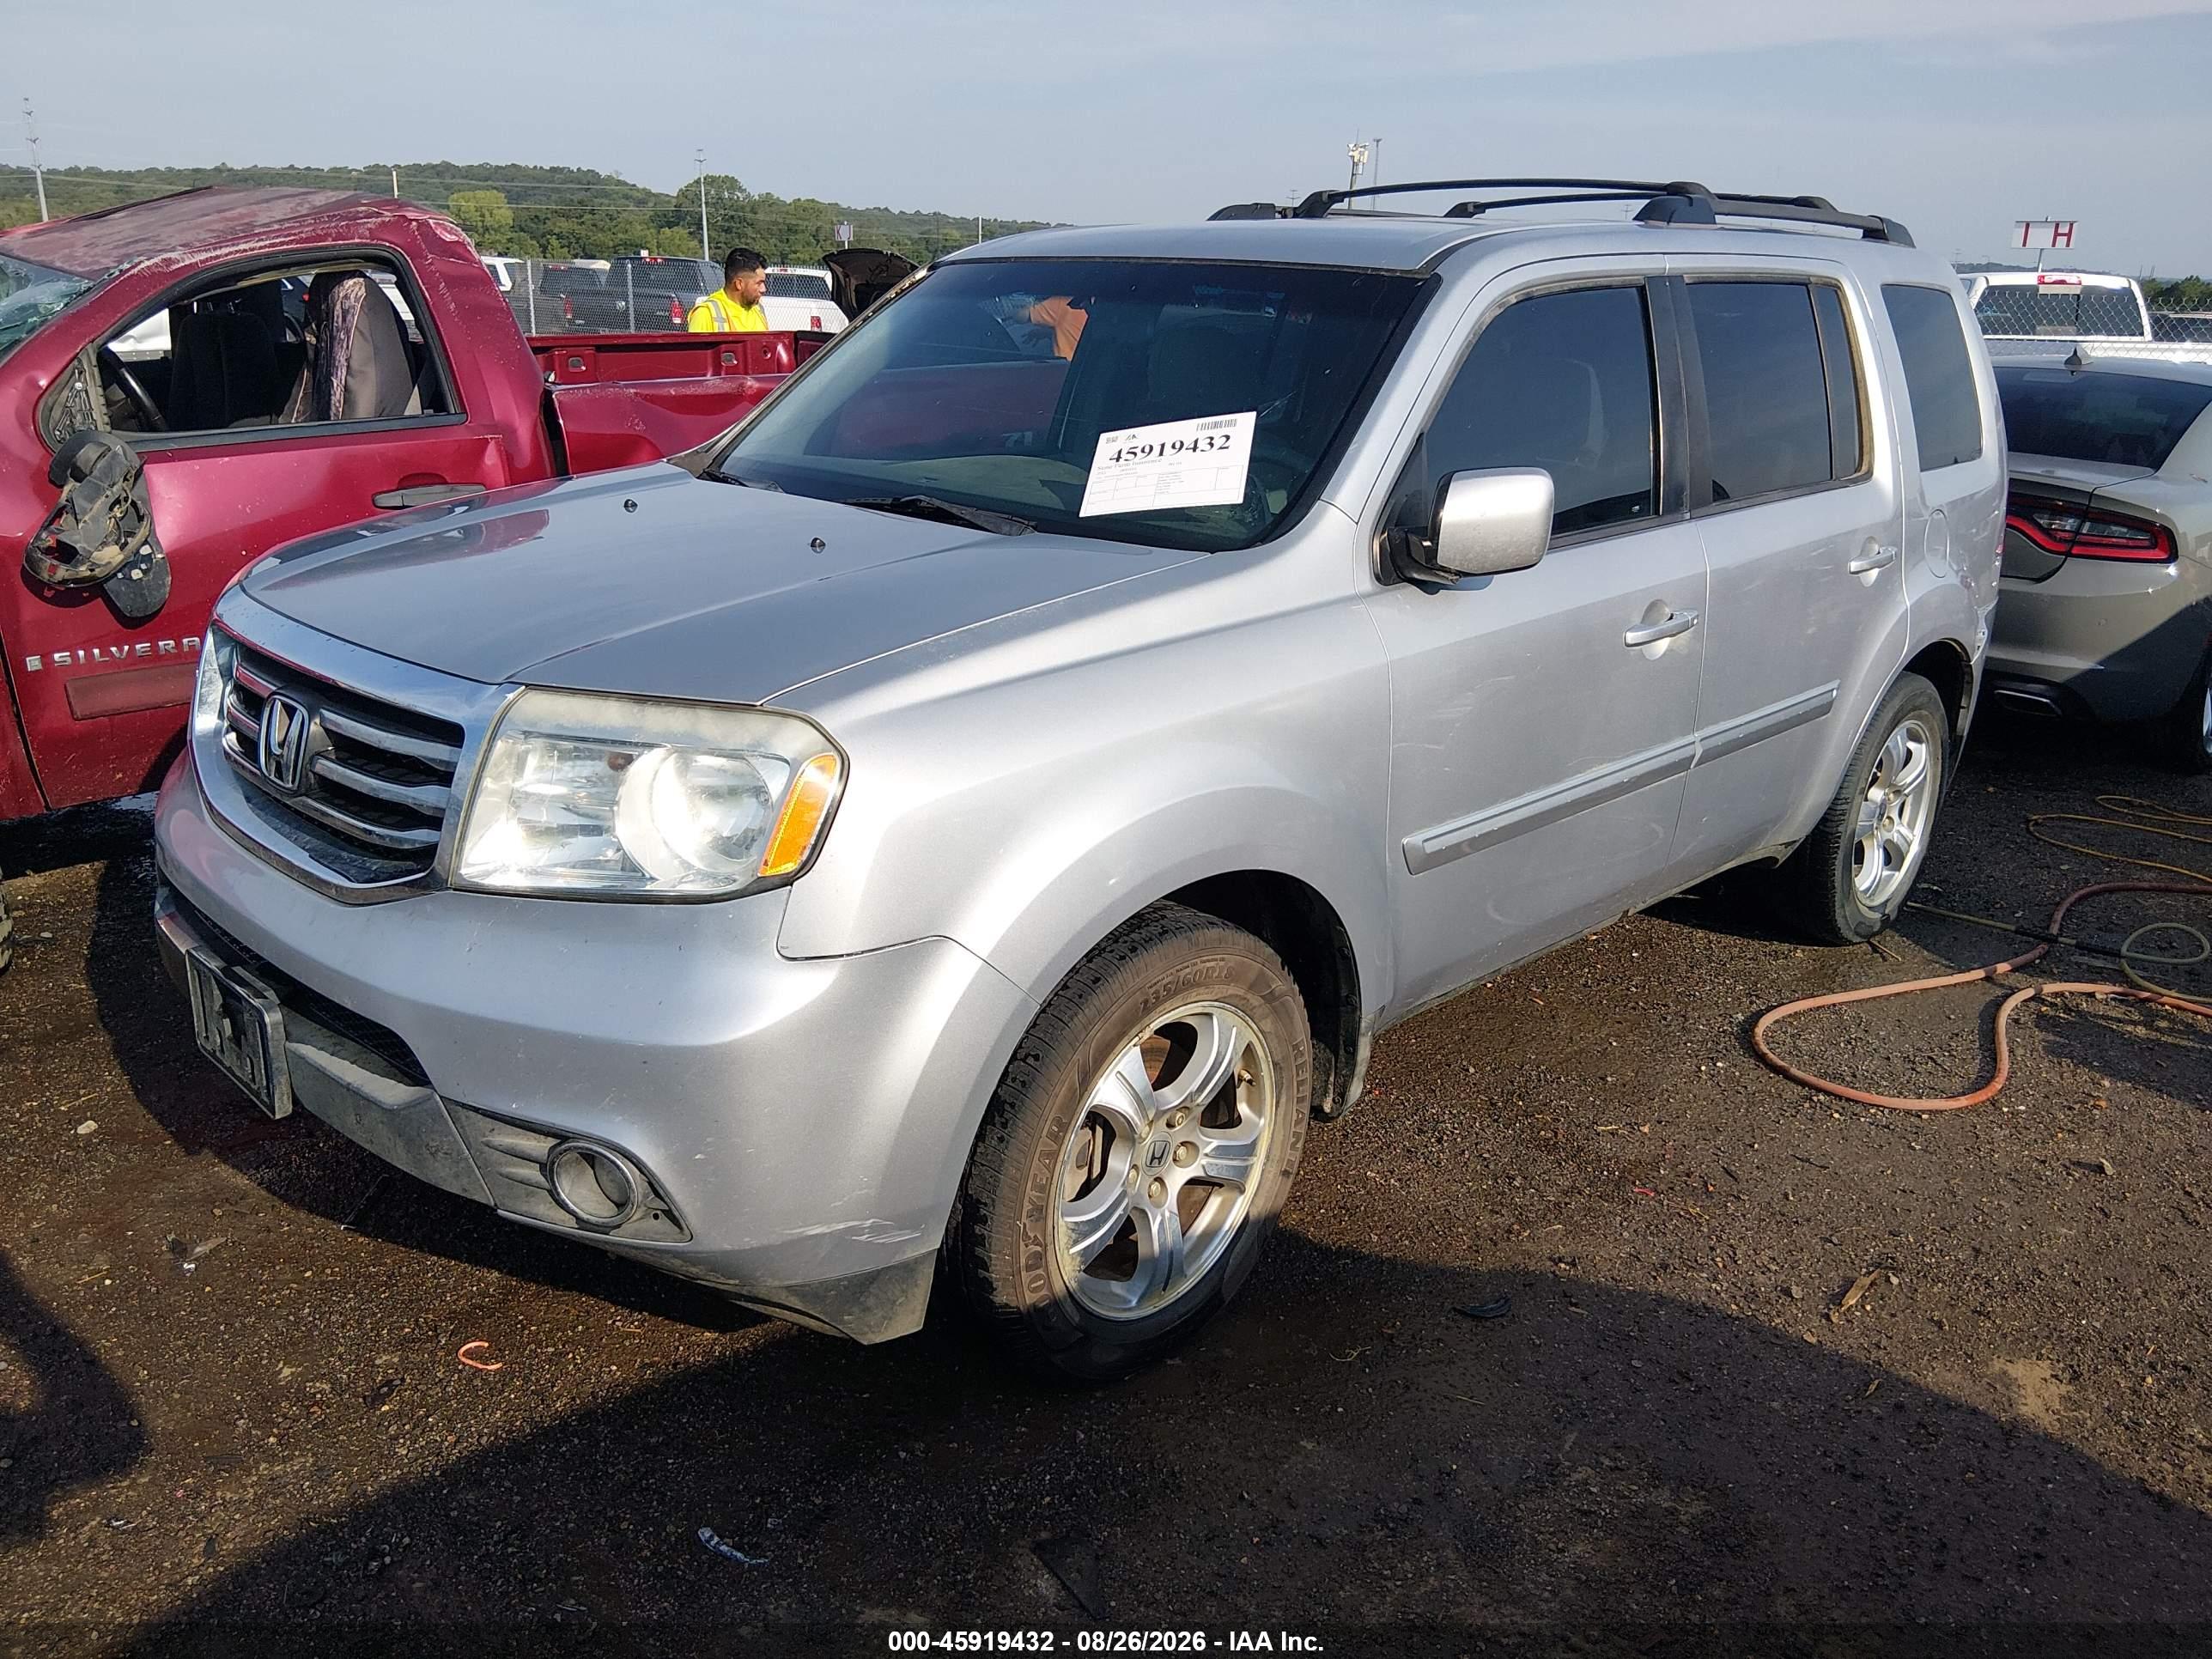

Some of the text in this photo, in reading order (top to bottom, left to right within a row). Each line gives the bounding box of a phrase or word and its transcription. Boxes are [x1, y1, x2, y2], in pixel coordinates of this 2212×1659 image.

[836, 225, 842, 240] K
[2051, 222, 2074, 247] H
[1109, 434, 1231, 463] 45919432
